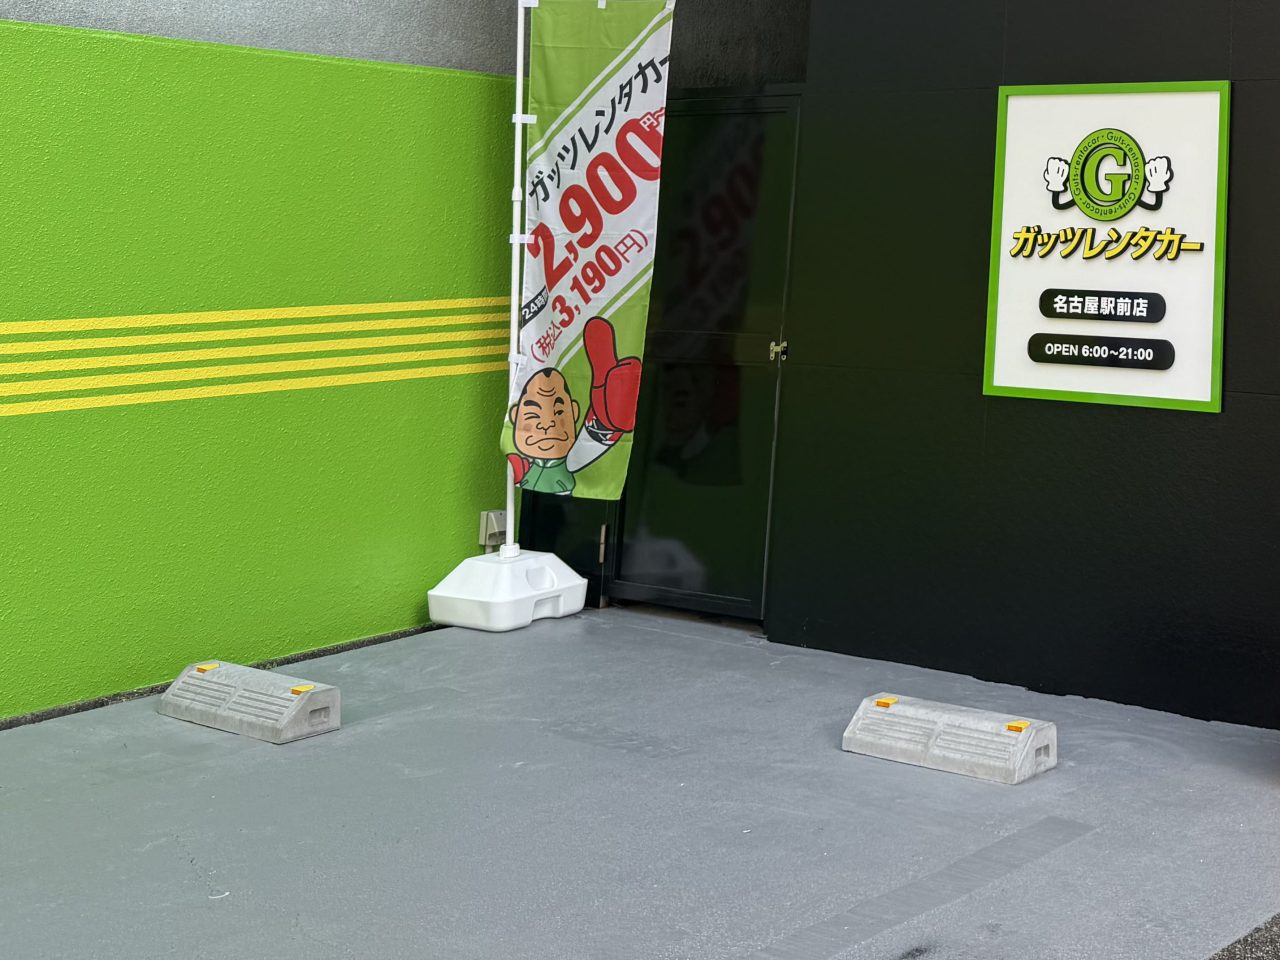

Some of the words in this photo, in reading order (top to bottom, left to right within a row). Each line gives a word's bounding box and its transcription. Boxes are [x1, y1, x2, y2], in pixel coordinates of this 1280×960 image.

[1009, 225, 1204, 261] ガッツレンタカー
[1053, 294, 1149, 317] 名古屋駅前店
[1044, 343, 1079, 357] OPEN
